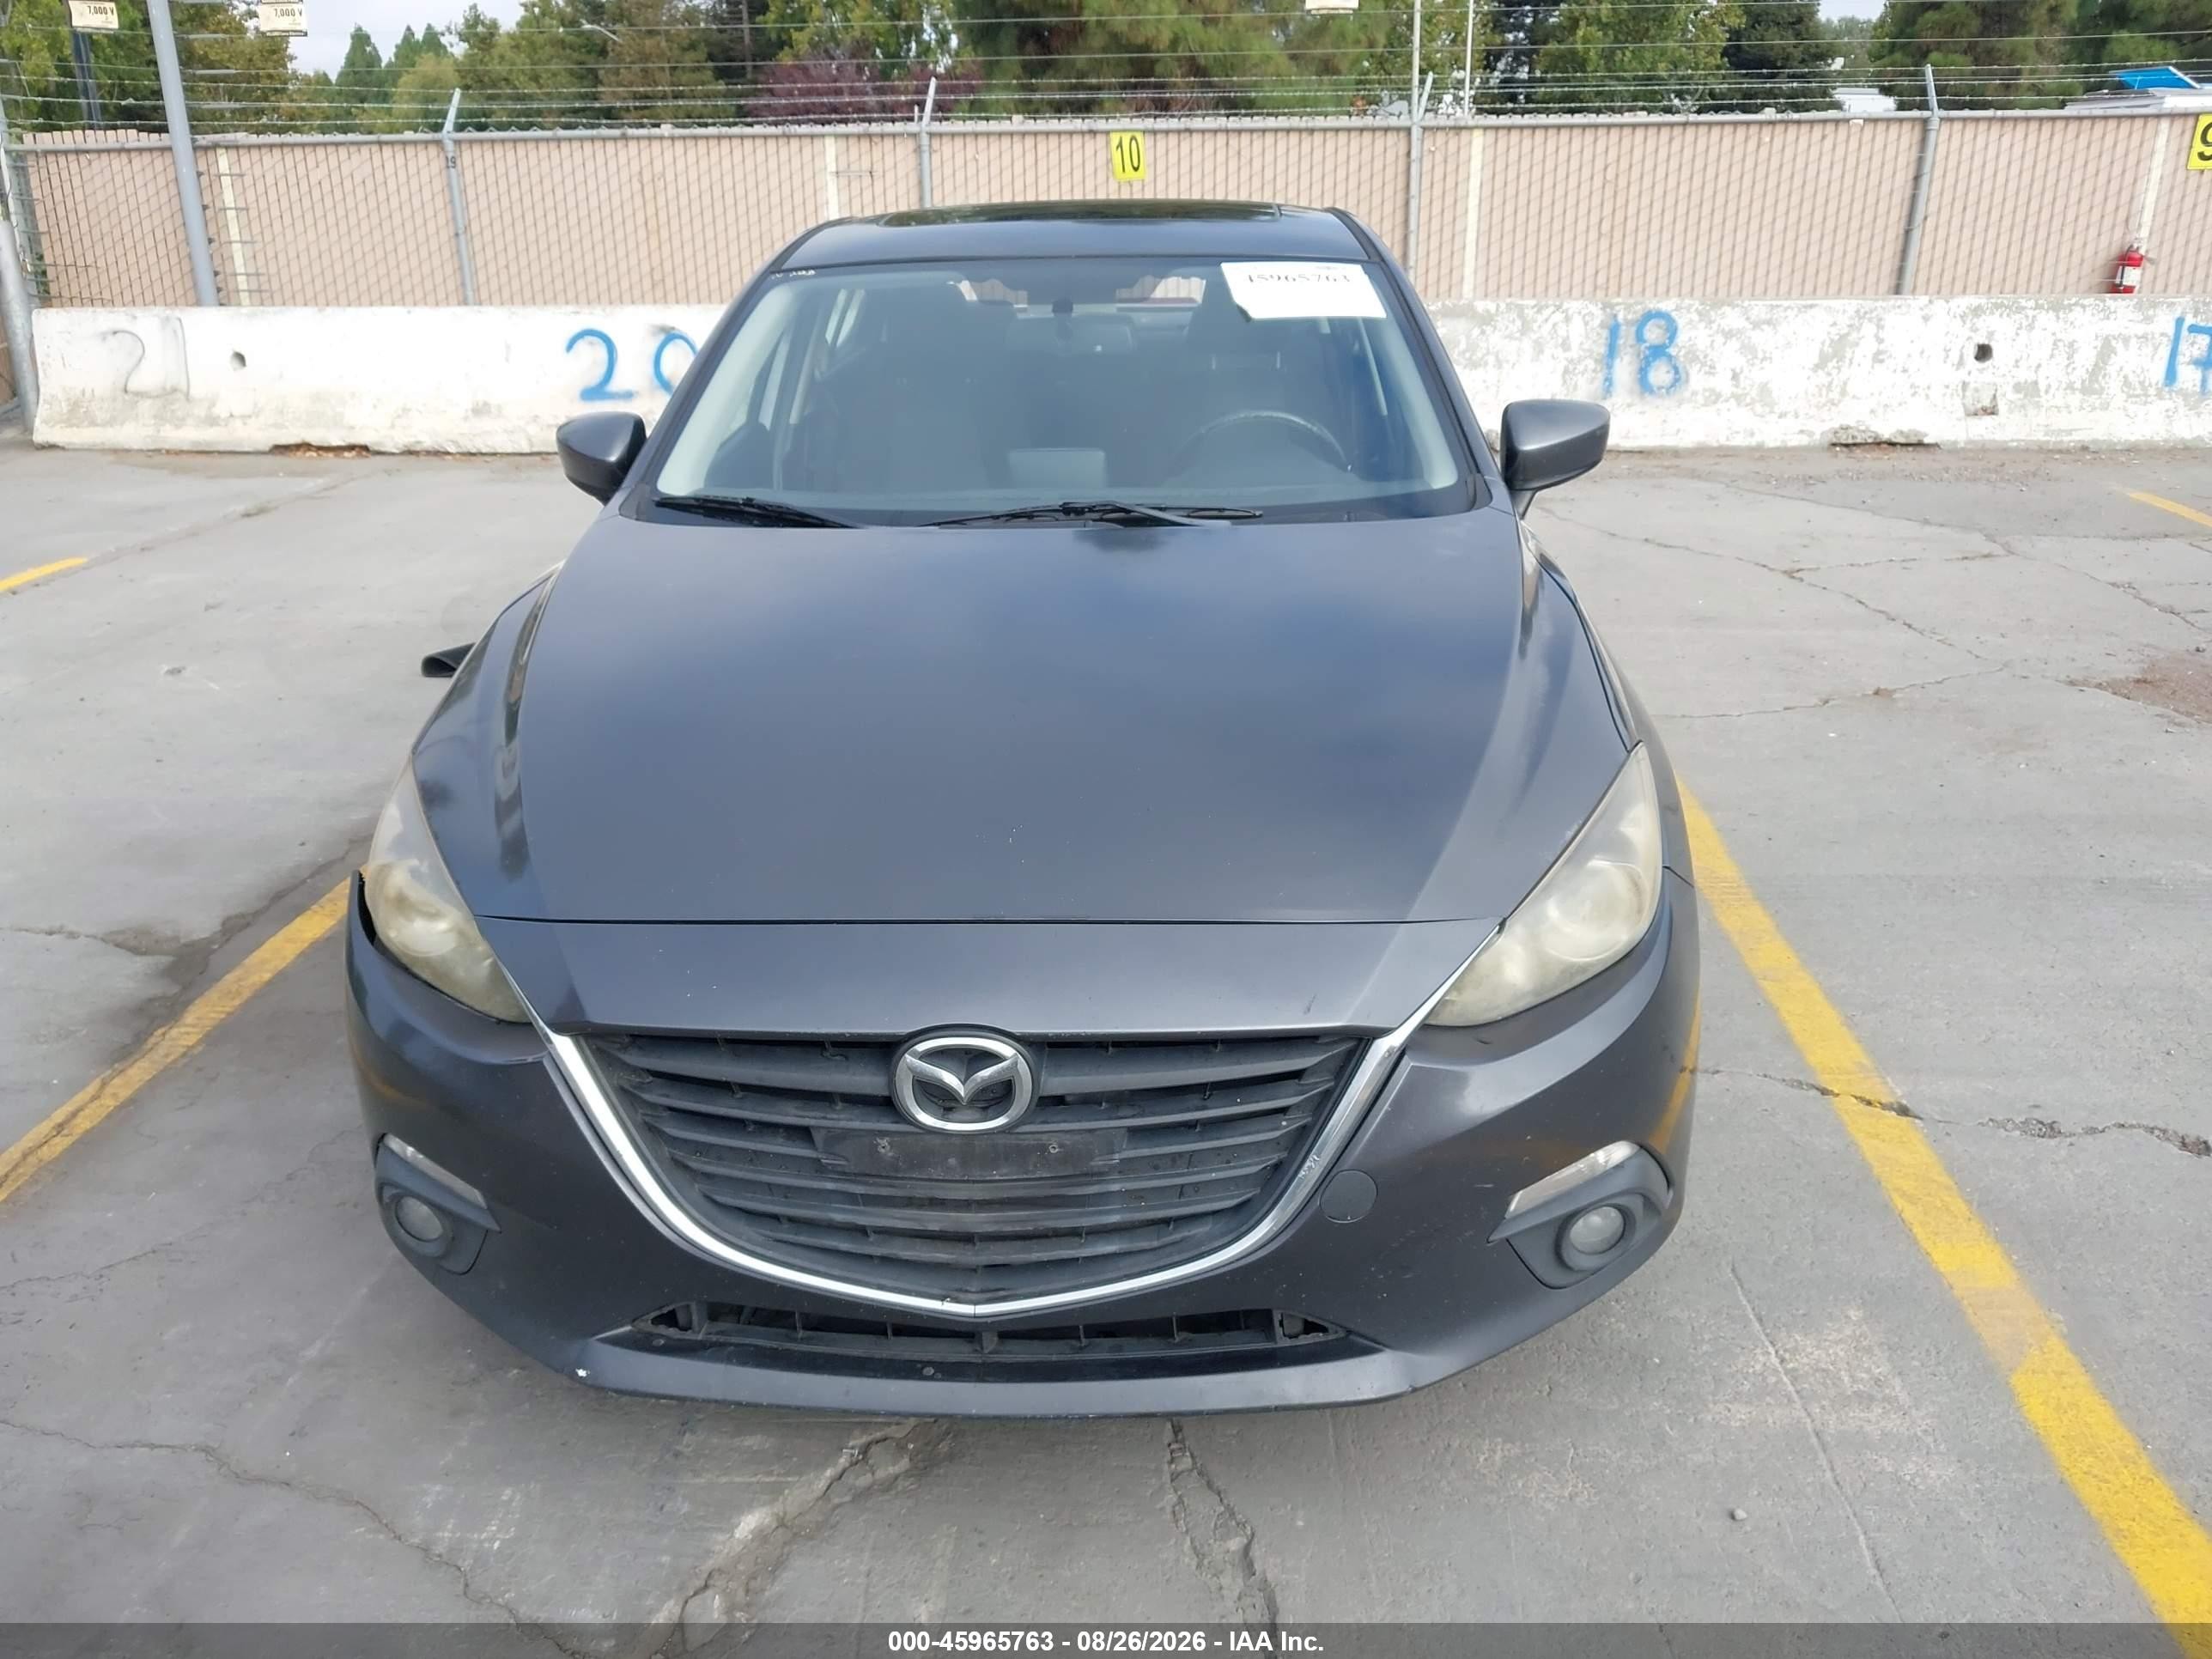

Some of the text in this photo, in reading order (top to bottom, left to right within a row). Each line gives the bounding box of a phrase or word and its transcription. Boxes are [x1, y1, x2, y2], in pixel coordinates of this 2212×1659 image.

[87, 5, 107, 15] 7,000
[274, 8, 295, 18] 7,000
[445, 155, 456, 169] 19
[1115, 135, 1140, 173] 10
[565, 329, 698, 402] 20
[1601, 310, 1680, 398] 18
[2163, 317, 2212, 397] 17
